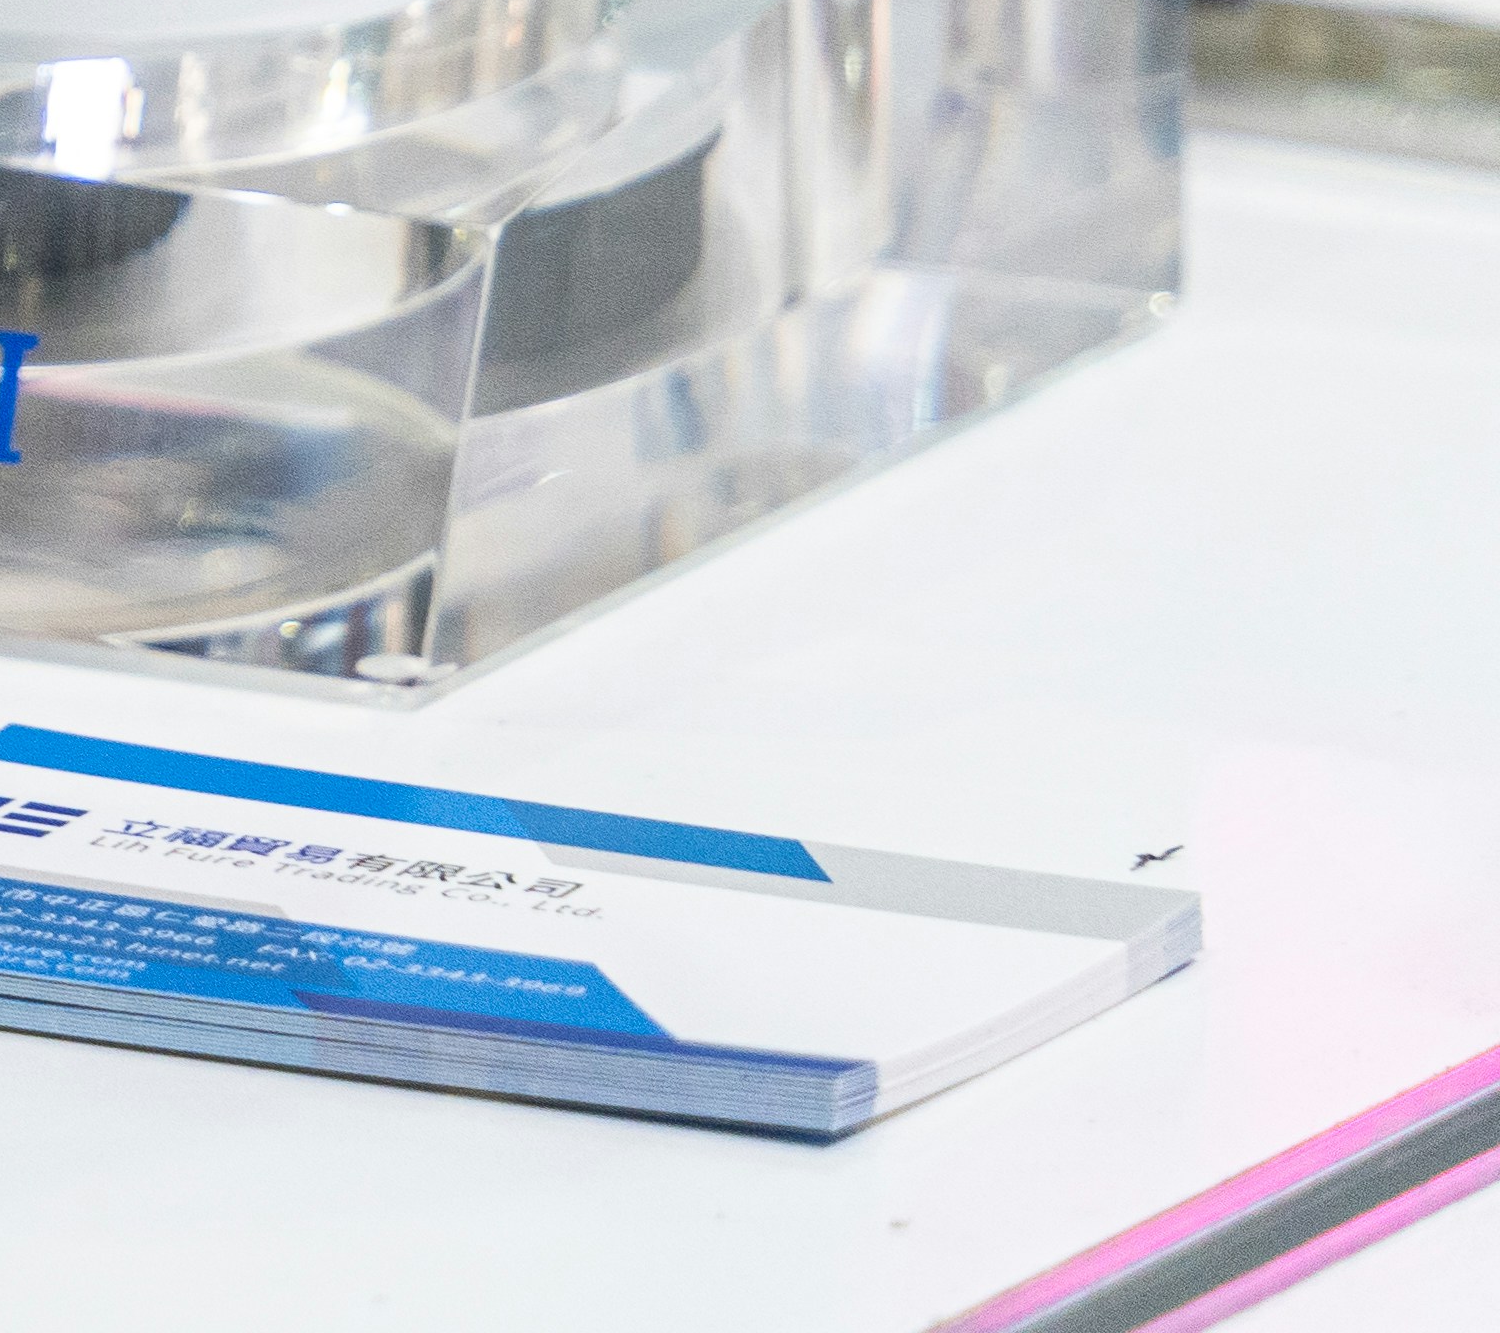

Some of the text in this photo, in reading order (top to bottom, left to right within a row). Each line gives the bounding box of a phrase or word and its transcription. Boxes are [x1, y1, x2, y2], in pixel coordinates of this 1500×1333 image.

[89, 835, 139, 855] Lih
[148, 846, 256, 869] Fure
[273, 861, 427, 897] Trading
[531, 899, 604, 920] Ltd.
